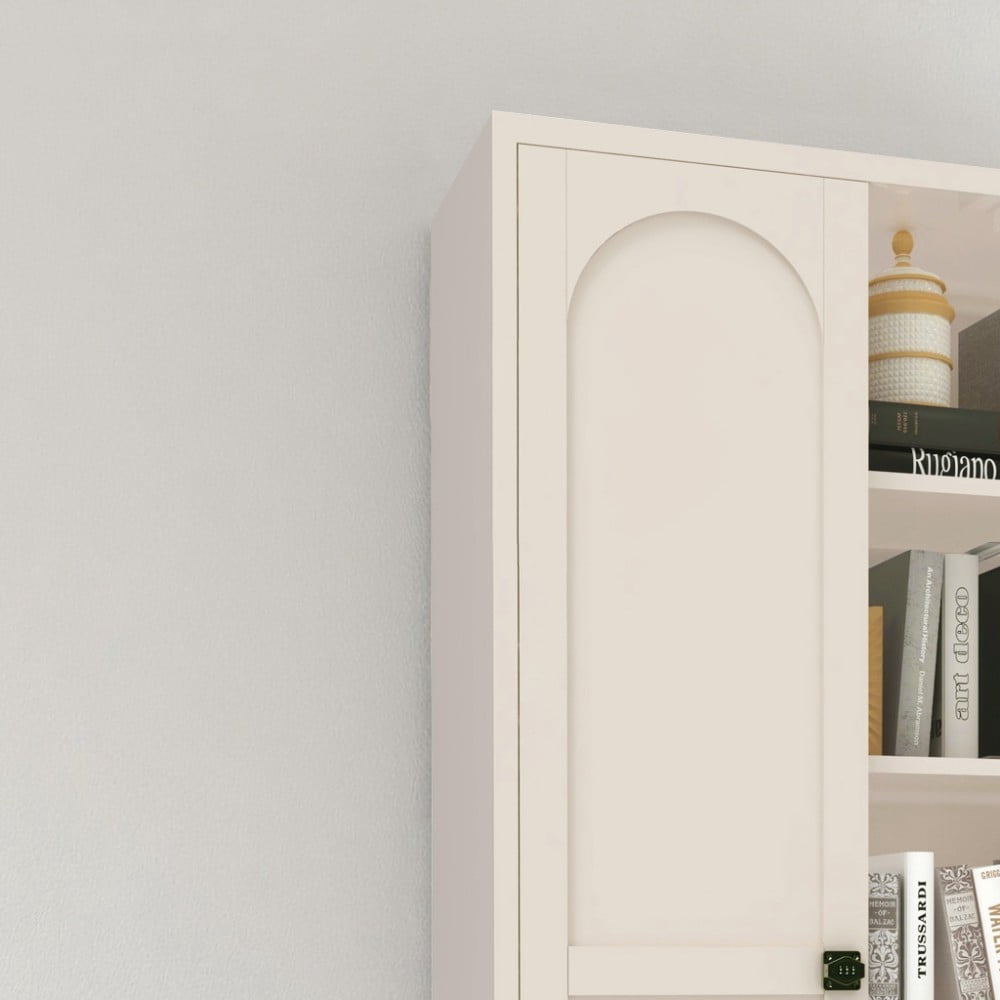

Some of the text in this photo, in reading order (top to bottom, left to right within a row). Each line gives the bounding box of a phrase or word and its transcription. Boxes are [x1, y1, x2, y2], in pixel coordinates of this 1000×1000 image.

[911, 447, 998, 479] Rugiano
[918, 566, 934, 663] An Architectural History
[953, 586, 969, 721] art deco
[918, 671, 926, 695] Daniel
[946, 894, 973, 905] MEMOIR
[917, 880, 927, 979] TRUSSARDI
[949, 912, 976, 922] BALZAC
